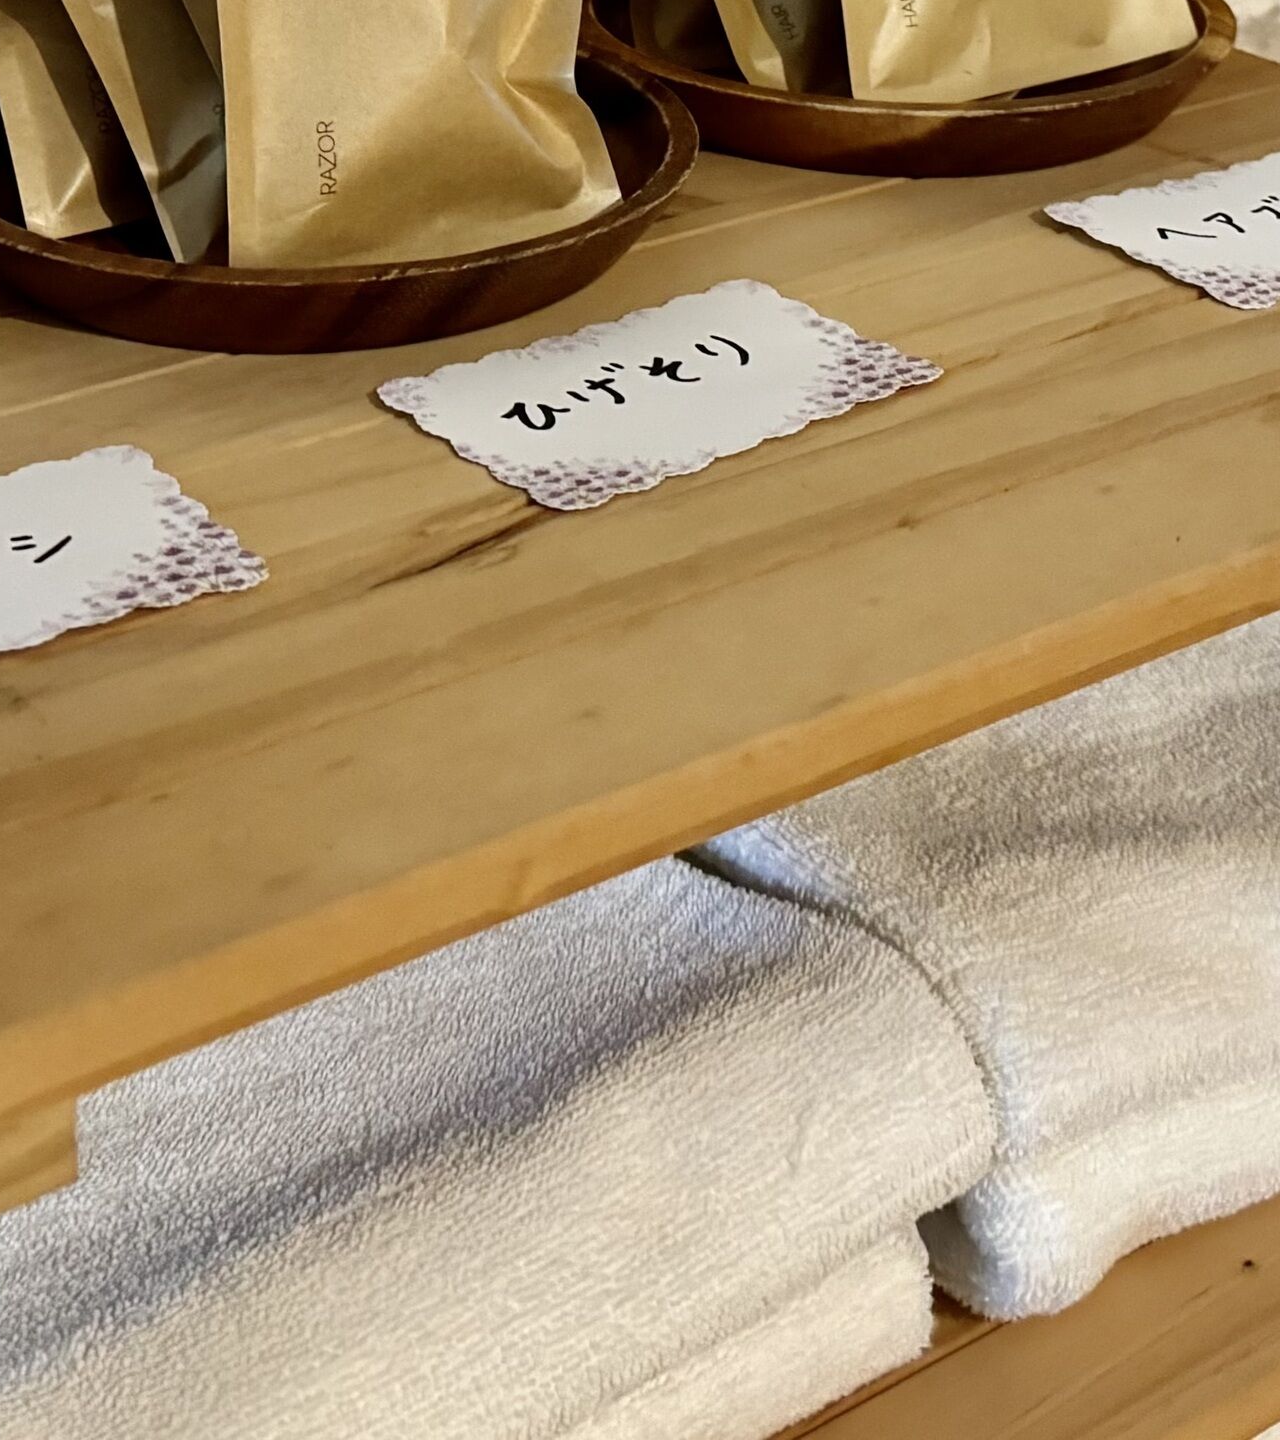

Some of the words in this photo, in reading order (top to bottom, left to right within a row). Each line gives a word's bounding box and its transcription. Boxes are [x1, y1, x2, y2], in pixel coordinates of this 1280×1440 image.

[316, 120, 337, 196] RAZOR
[500, 333, 751, 431] ひげそり
